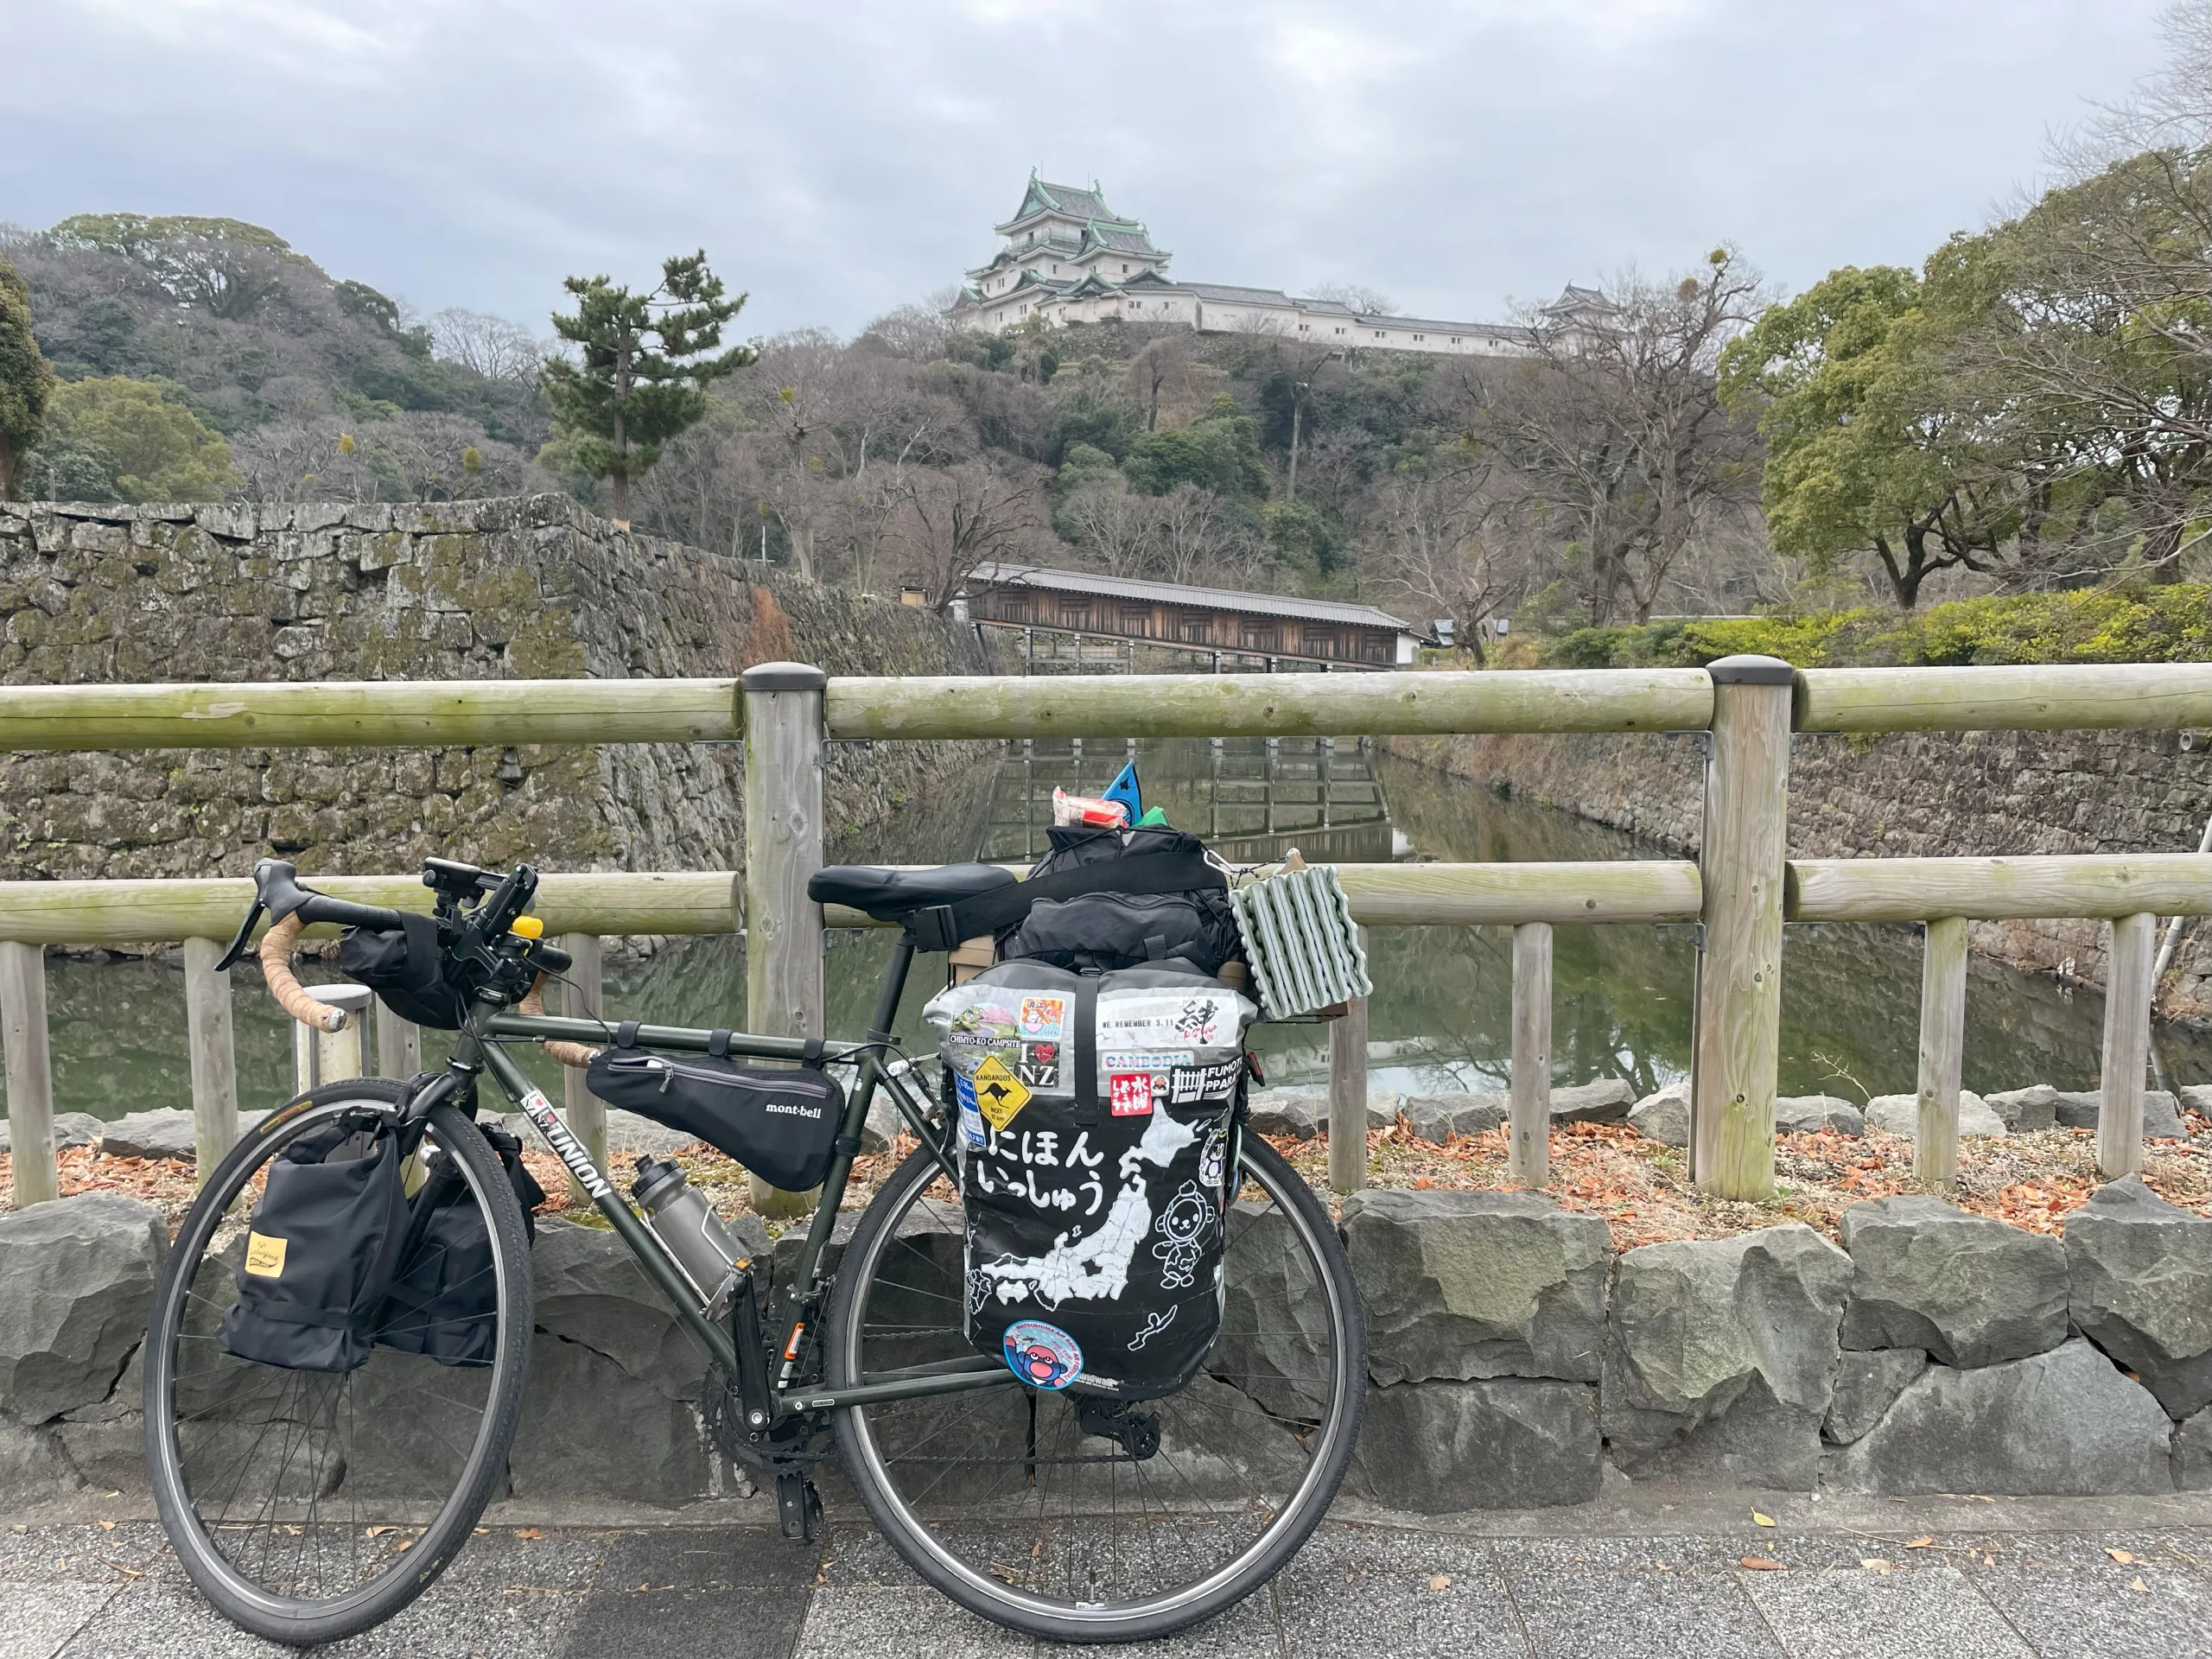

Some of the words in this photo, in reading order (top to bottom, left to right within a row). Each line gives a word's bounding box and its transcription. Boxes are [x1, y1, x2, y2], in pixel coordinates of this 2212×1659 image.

[1115, 1020, 1152, 1028] REMEMBER
[1155, 1019, 1173, 1027] 3.11
[950, 1035, 987, 1046] CHIMYO-KO
[987, 1038, 1021, 1048] CAMPSITE
[1020, 1043, 1028, 1063] I
[1105, 1053, 1192, 1068] CAMBODIA
[1019, 1065, 1054, 1086] NZ
[990, 1106, 1002, 1115] NEXT
[988, 1125, 1104, 1168] にほん
[546, 1122, 613, 1199] UNION
[976, 1160, 1103, 1216] いっしゅう
[1015, 1323, 1055, 1333] MATSUSHIMA
[1054, 1332, 1066, 1340] AIR
[1065, 1338, 1077, 1352] BASE
